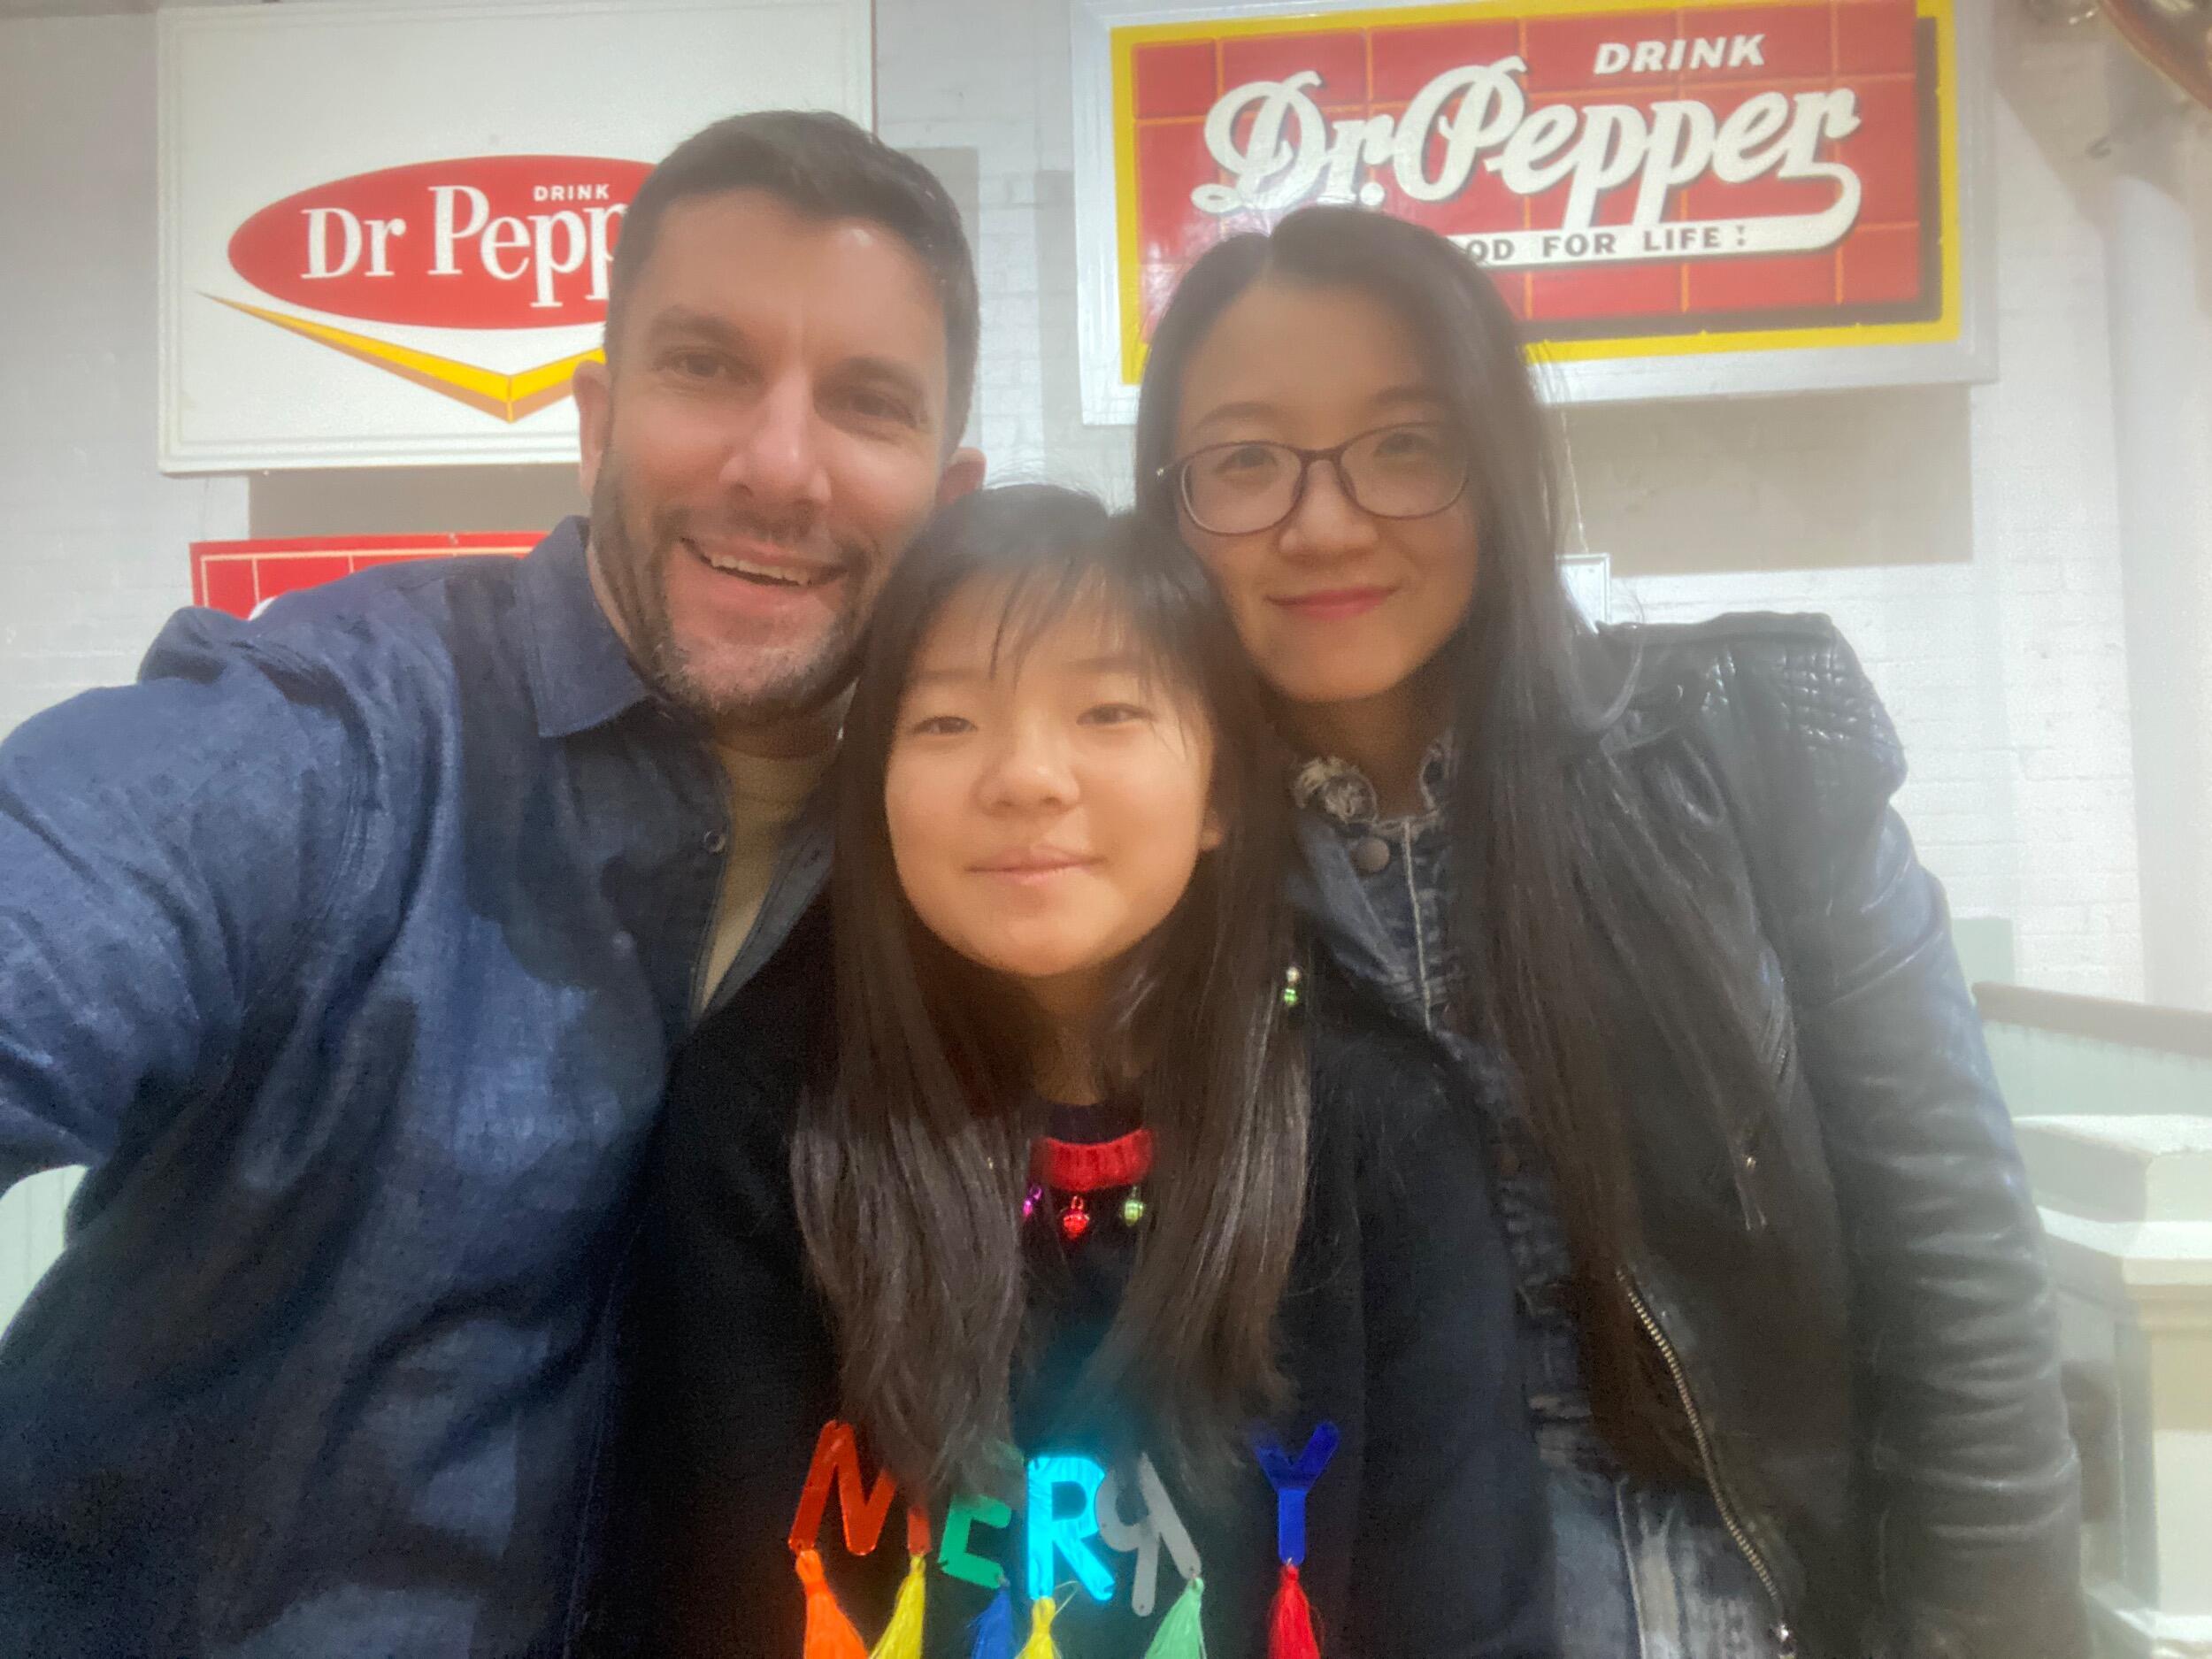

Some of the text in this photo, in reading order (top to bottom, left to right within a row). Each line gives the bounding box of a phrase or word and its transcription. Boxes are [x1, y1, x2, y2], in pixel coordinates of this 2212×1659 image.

[1594, 34, 1767, 74] DRINK
[1393, 55, 1862, 234] Pepper
[533, 183, 610, 202] DRINK
[300, 185, 629, 308] Dr Pepp
[1466, 238, 1516, 263] OD
[1541, 233, 1617, 258] FOR
